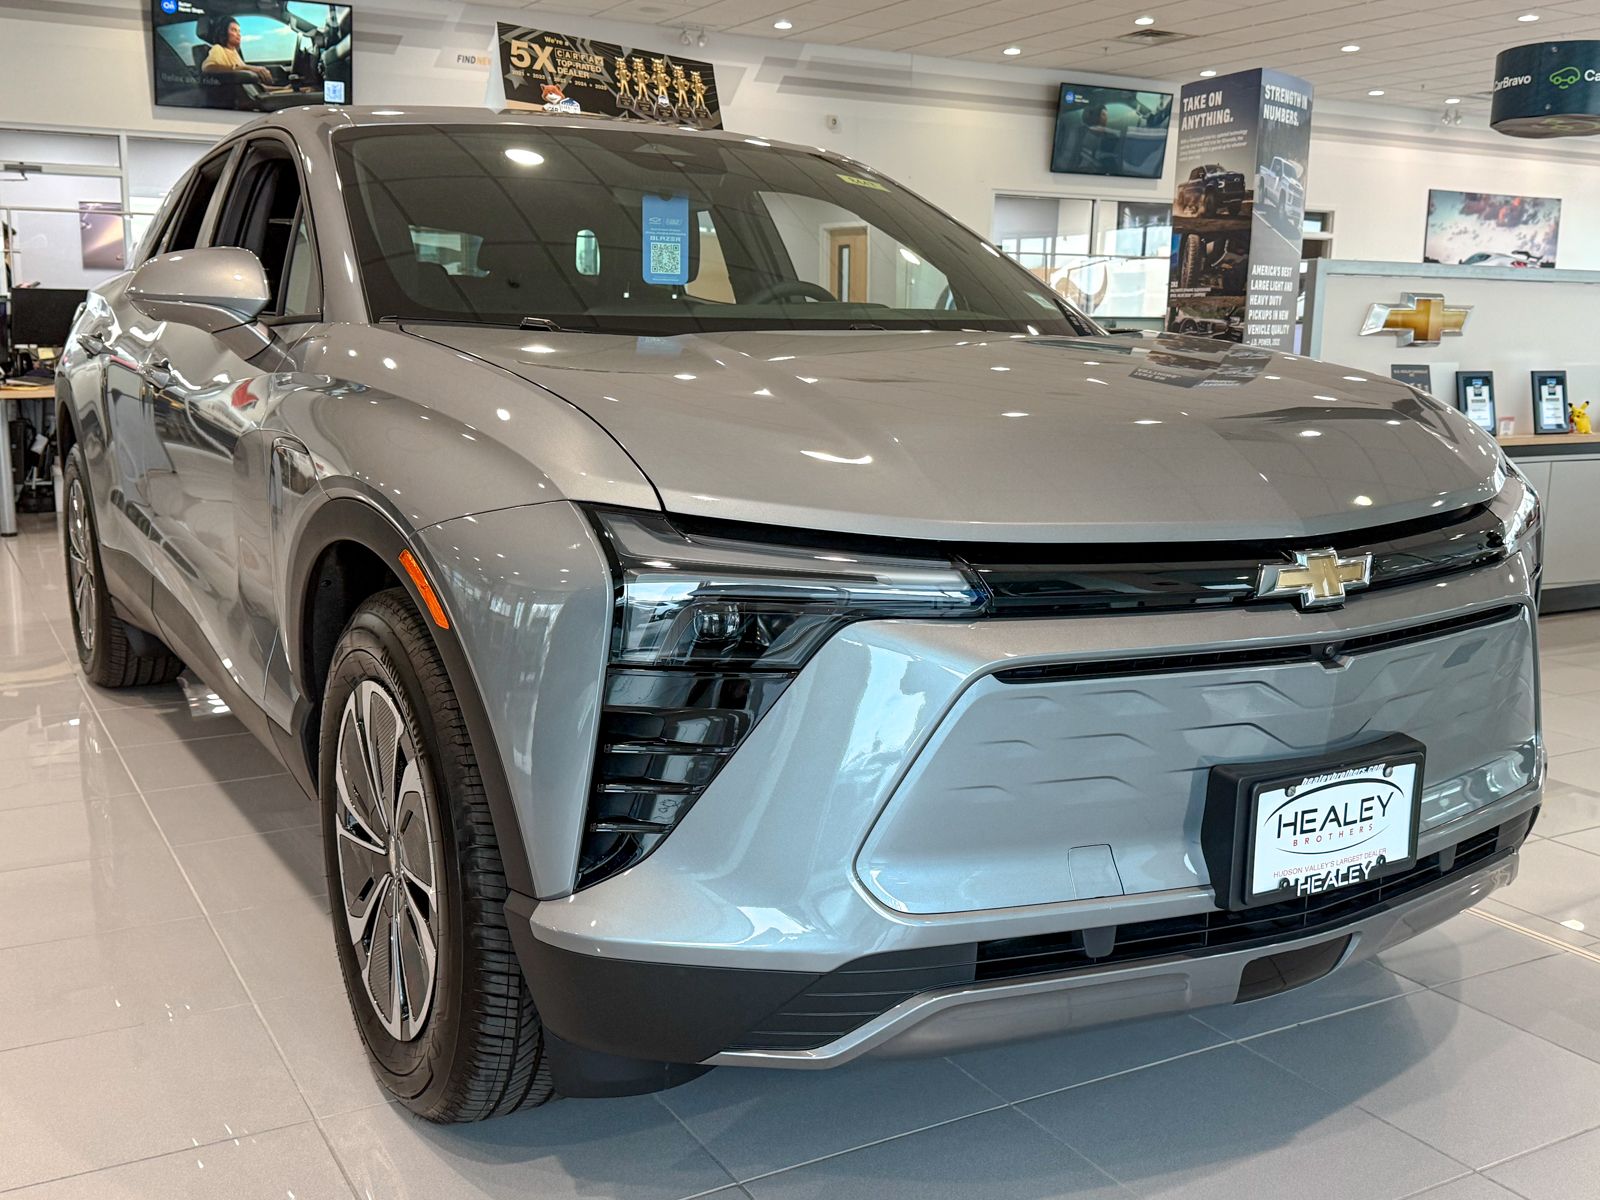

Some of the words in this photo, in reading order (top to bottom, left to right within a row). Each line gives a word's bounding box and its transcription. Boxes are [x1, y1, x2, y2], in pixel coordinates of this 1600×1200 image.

[544, 36, 563, 45] We're
[456, 54, 476, 64] FIND
[510, 39, 557, 74] 5X
[556, 58, 602, 73] TOP-RATED
[557, 67, 590, 79] DEALER
[1182, 93, 1206, 113] TAKE
[1208, 90, 1223, 107] ON
[1264, 84, 1301, 108] STRENGTH
[1302, 95, 1308, 110] IN
[1181, 108, 1234, 131] ANYTHING.
[1263, 104, 1300, 127] NUMBERS.
[1251, 264, 1280, 277] AMERICA'S
[1281, 266, 1292, 277] BEST
[1250, 279, 1270, 290] LARGE
[1270, 280, 1284, 291] LIGHT
[1284, 281, 1293, 292] AND
[1249, 294, 1268, 305] HEAVY
[1269, 295, 1282, 306] DUTY
[1248, 309, 1272, 320] PICKUPS
[1247, 324, 1270, 335] VEHICLE
[1271, 324, 1289, 336] QUALITY
[1301, 763, 1386, 786] healeybrothers.com
[1277, 792, 1394, 839] HEALEY
[1292, 823, 1373, 847] BROTHERS
[1273, 866, 1303, 878] HUDSON
[1304, 860, 1335, 874] VALLEY'S
[1336, 854, 1363, 866] LARGEST
[1364, 848, 1387, 859] DEALER
[1296, 862, 1372, 897] HEALEY
